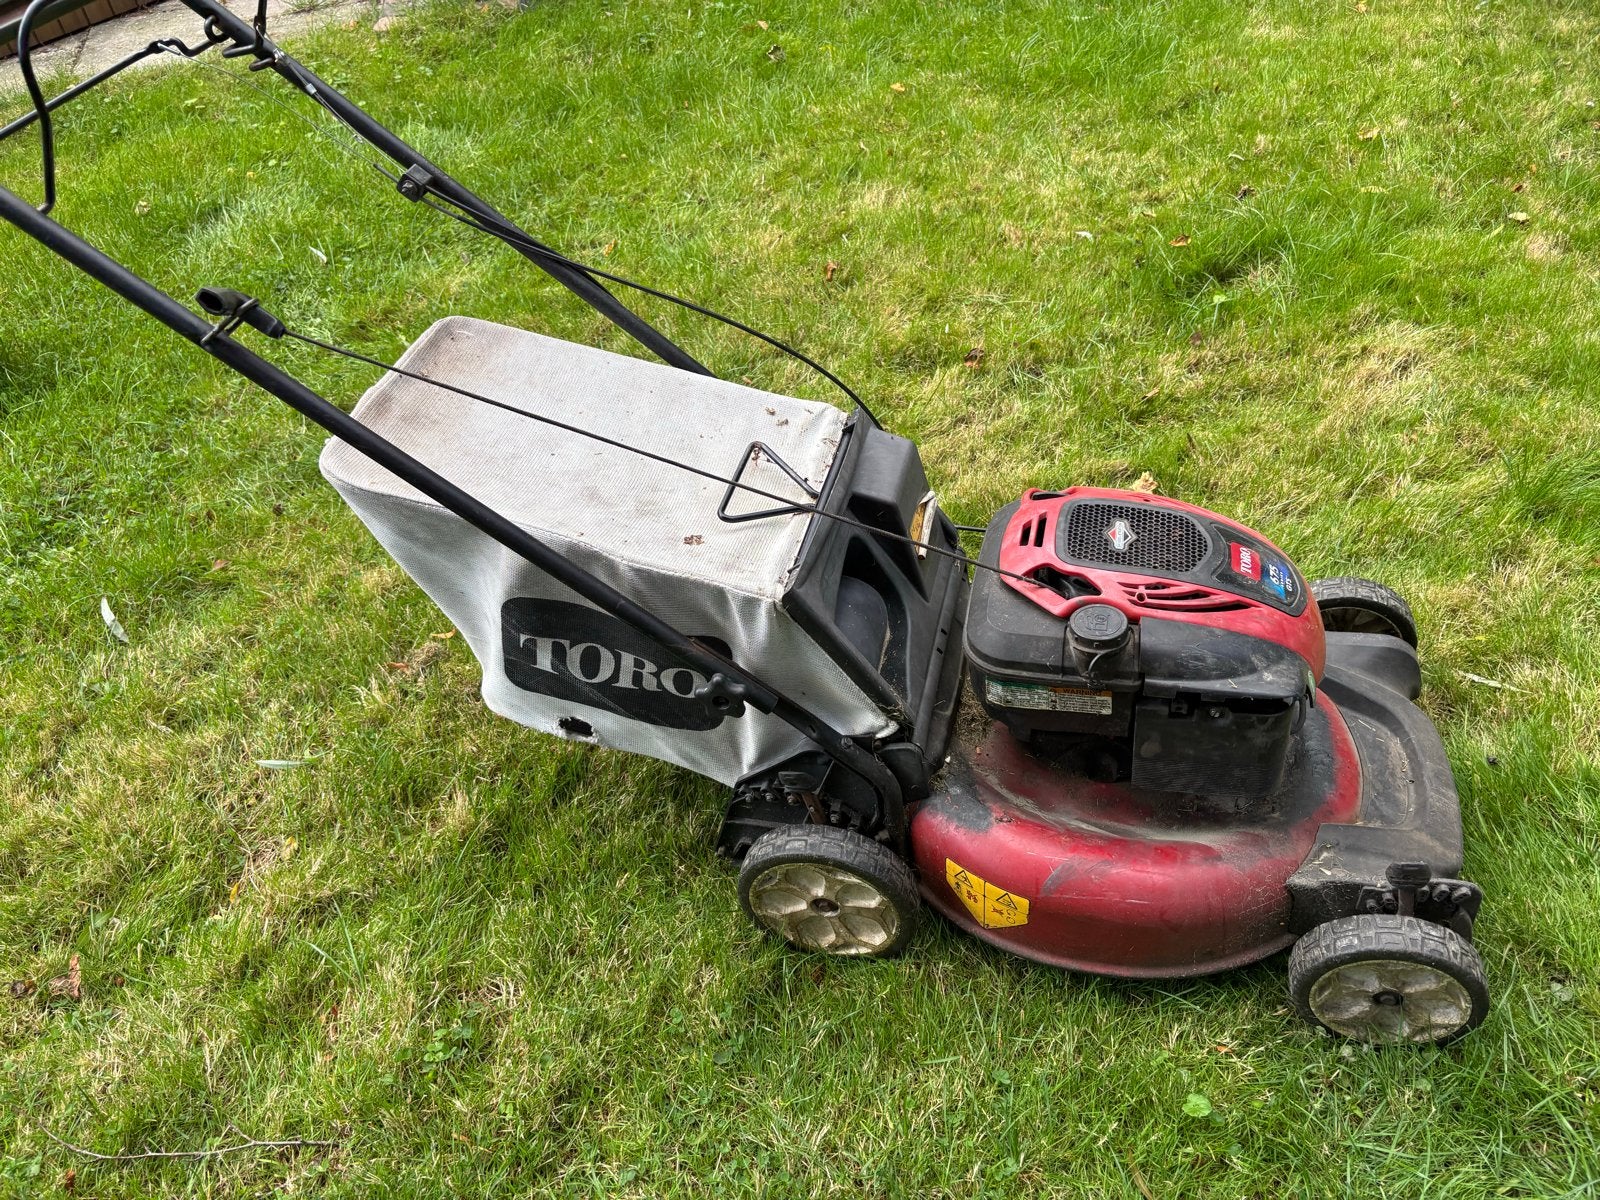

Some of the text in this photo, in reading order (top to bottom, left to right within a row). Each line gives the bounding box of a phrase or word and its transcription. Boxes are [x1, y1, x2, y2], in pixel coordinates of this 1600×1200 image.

[1240, 547, 1252, 574] TORO
[1269, 564, 1279, 585] 675
[519, 633, 708, 699] TORO
